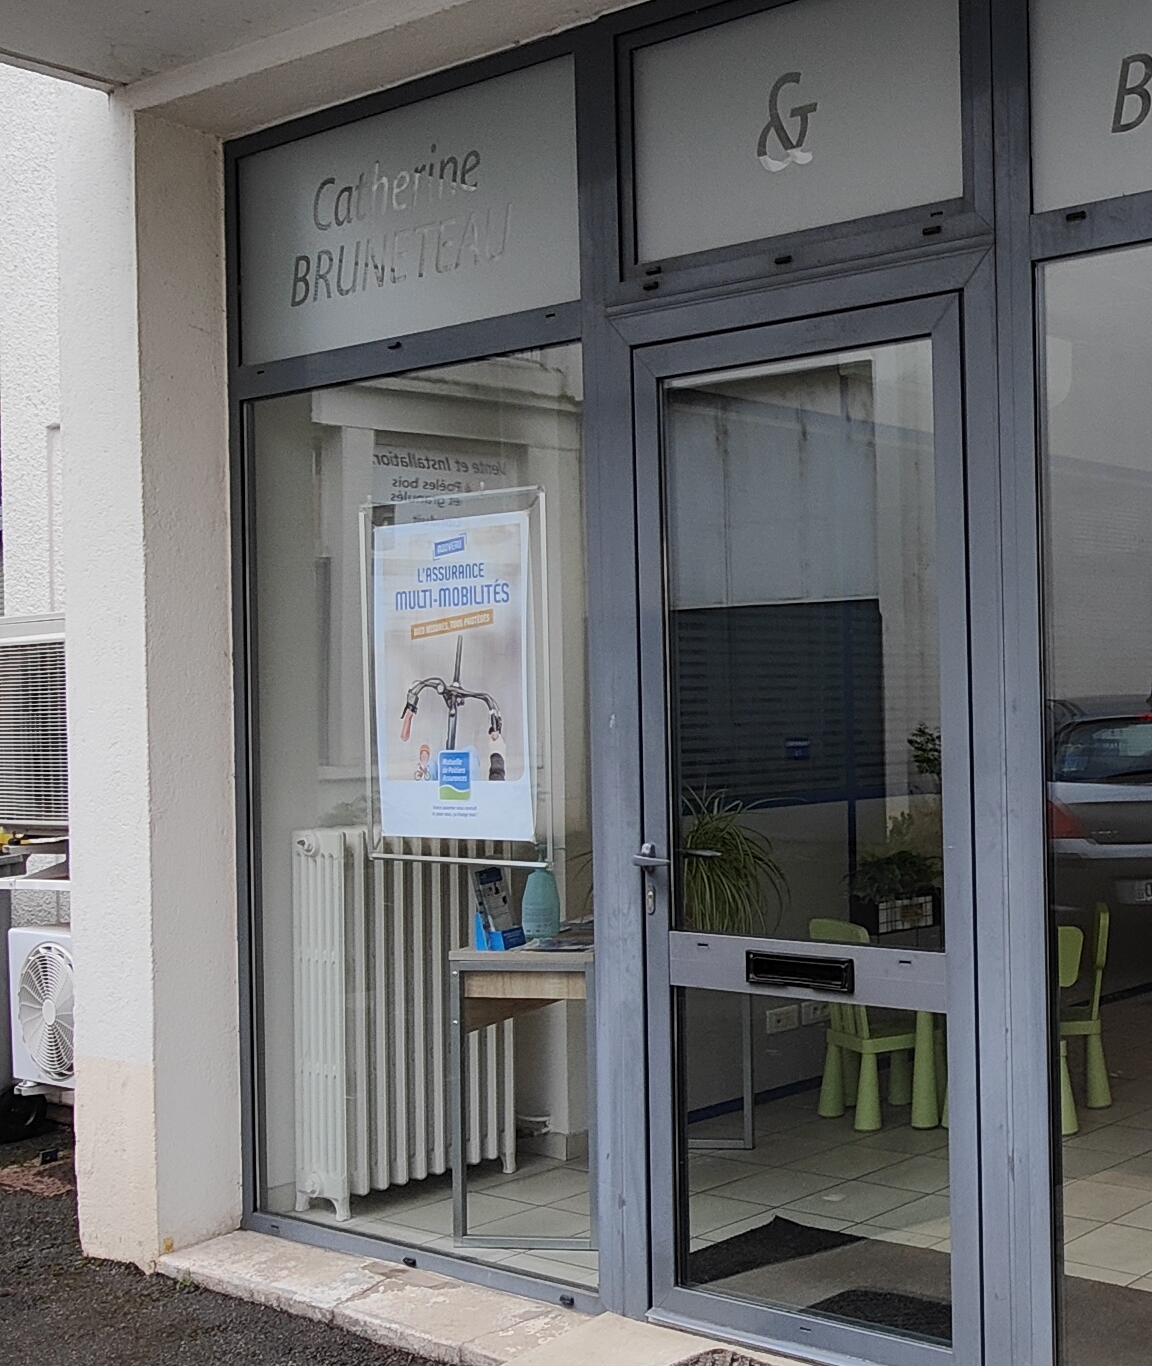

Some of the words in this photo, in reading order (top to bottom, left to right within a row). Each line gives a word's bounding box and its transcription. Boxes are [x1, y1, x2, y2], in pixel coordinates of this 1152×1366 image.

[755, 71, 818, 173] &
[312, 143, 482, 232] Catherine
[290, 202, 513, 309] BRUNETEAU
[395, 579, 510, 611] MULTI-MOBILITÉS
[417, 562, 485, 583] L'ASSURANCE
